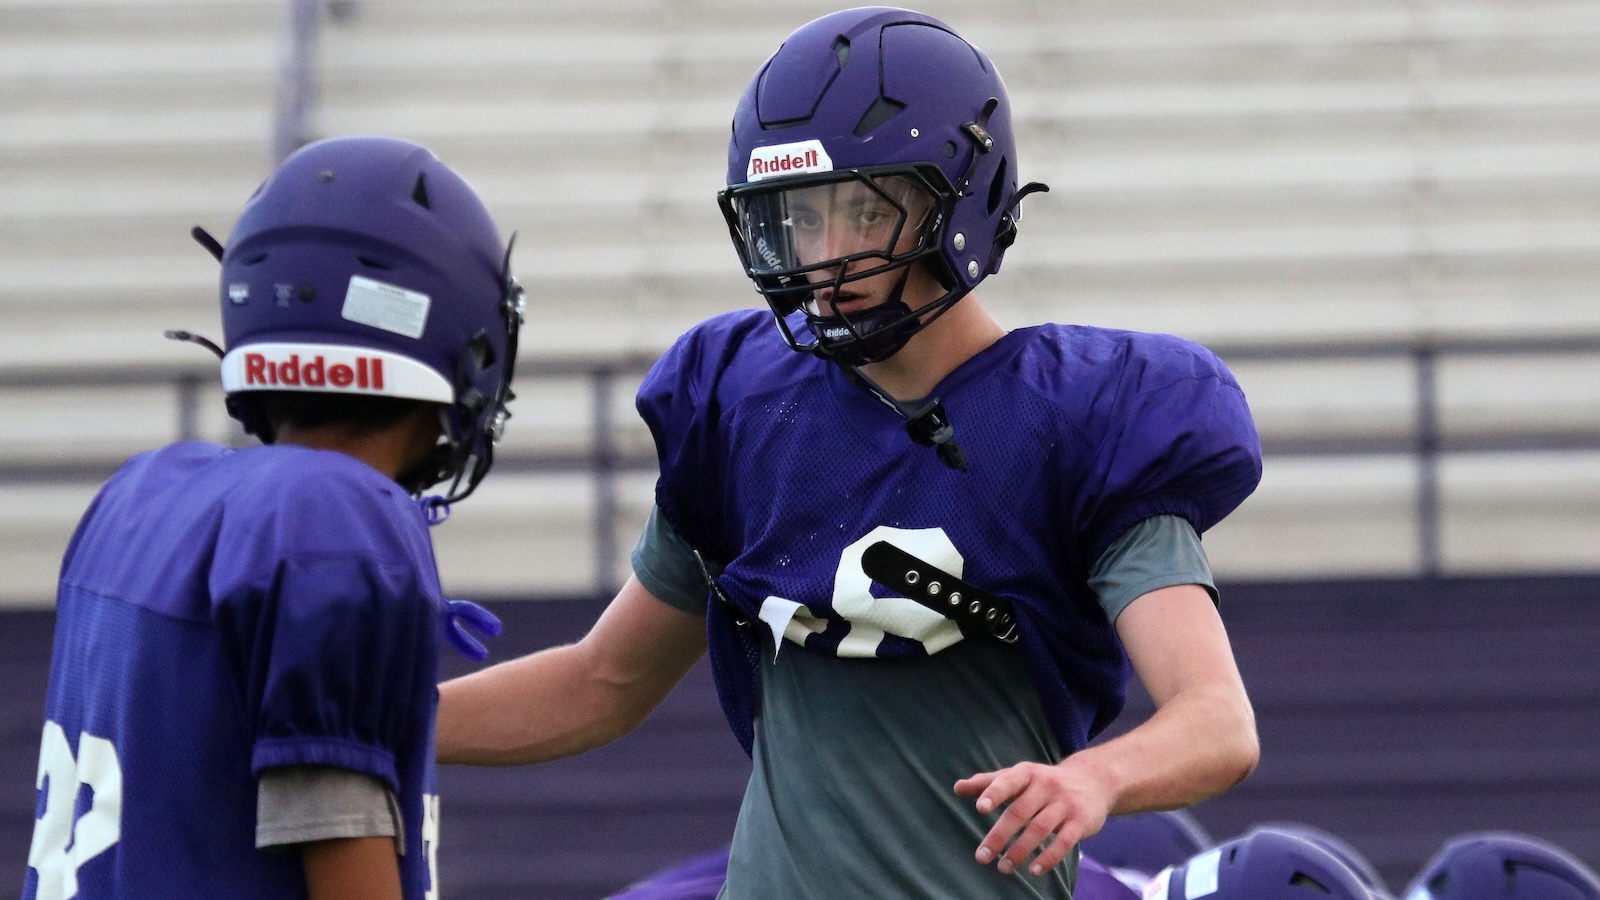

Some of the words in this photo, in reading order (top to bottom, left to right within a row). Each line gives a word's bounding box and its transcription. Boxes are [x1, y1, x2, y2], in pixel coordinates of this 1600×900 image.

[752, 150, 818, 175] Riddell
[826, 328, 851, 338] Ridde
[244, 353, 384, 389] Riddell
